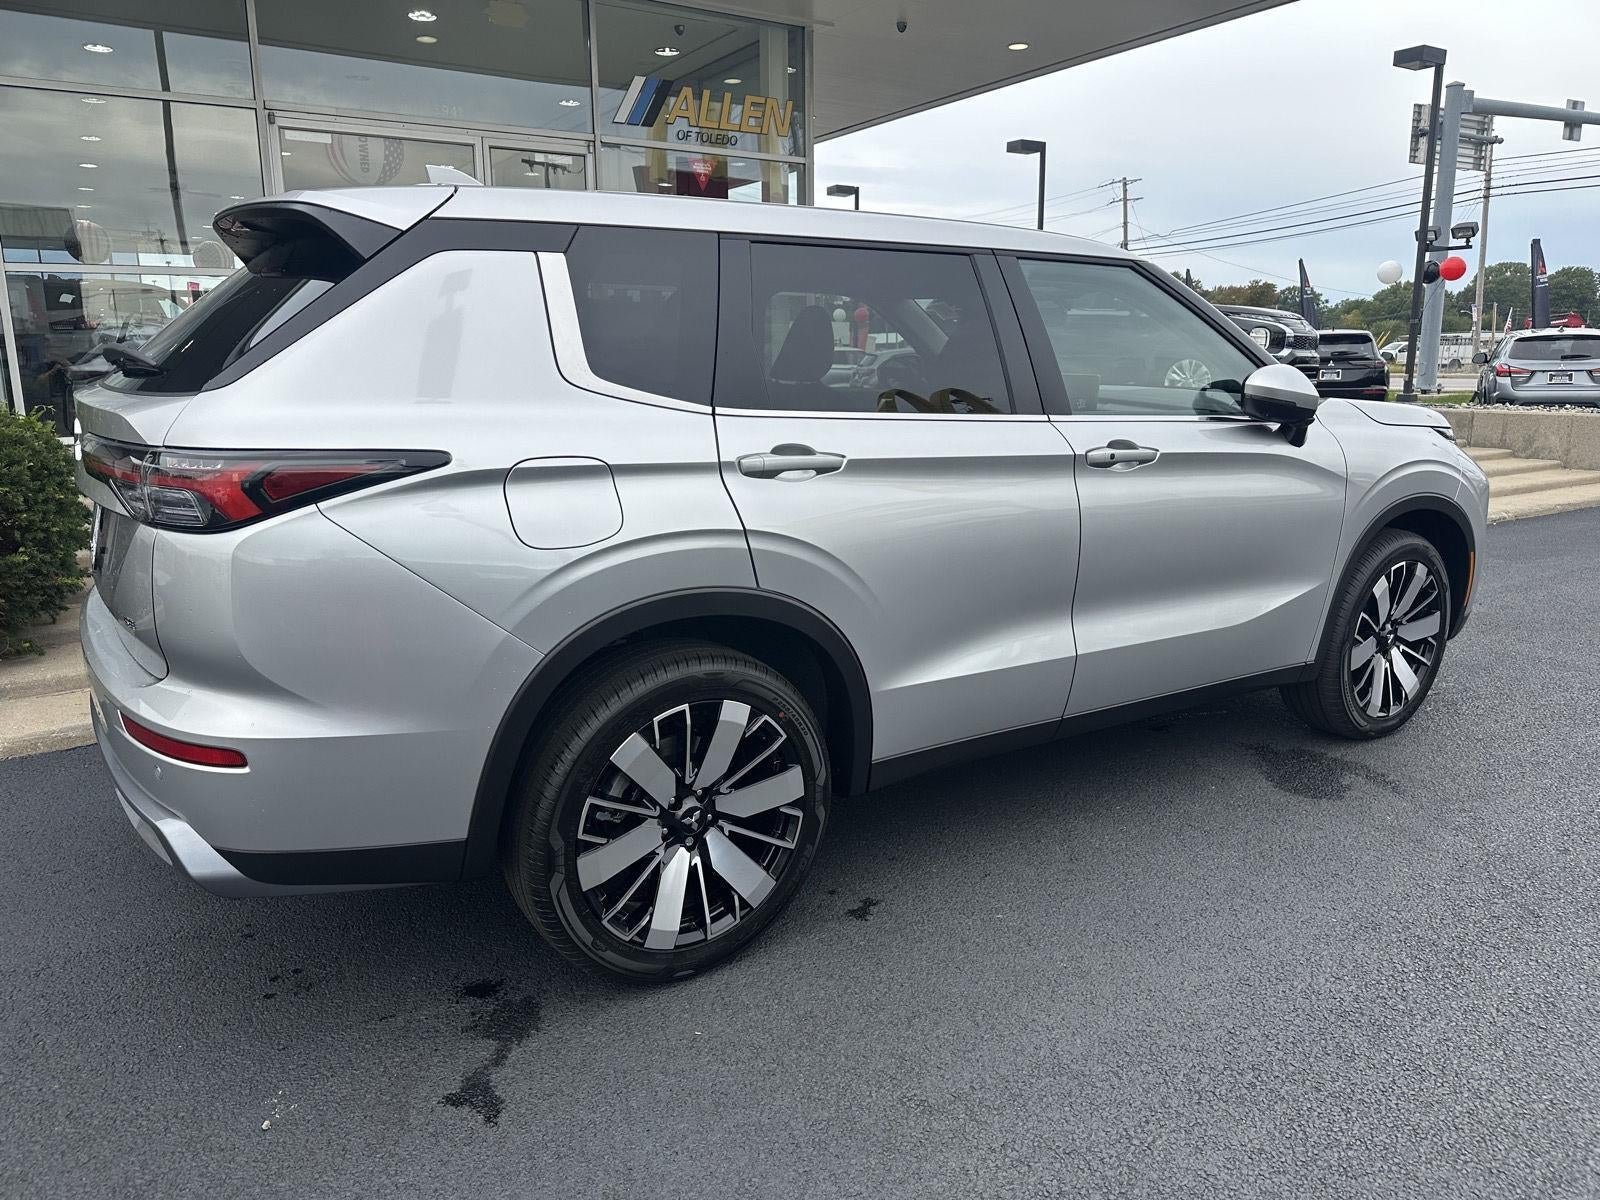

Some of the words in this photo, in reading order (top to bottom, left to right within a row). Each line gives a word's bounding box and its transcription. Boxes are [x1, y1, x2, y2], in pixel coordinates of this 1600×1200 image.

[666, 86, 794, 137] ALLEN
[677, 129, 692, 141] OF
[695, 131, 738, 146] TOLEDO
